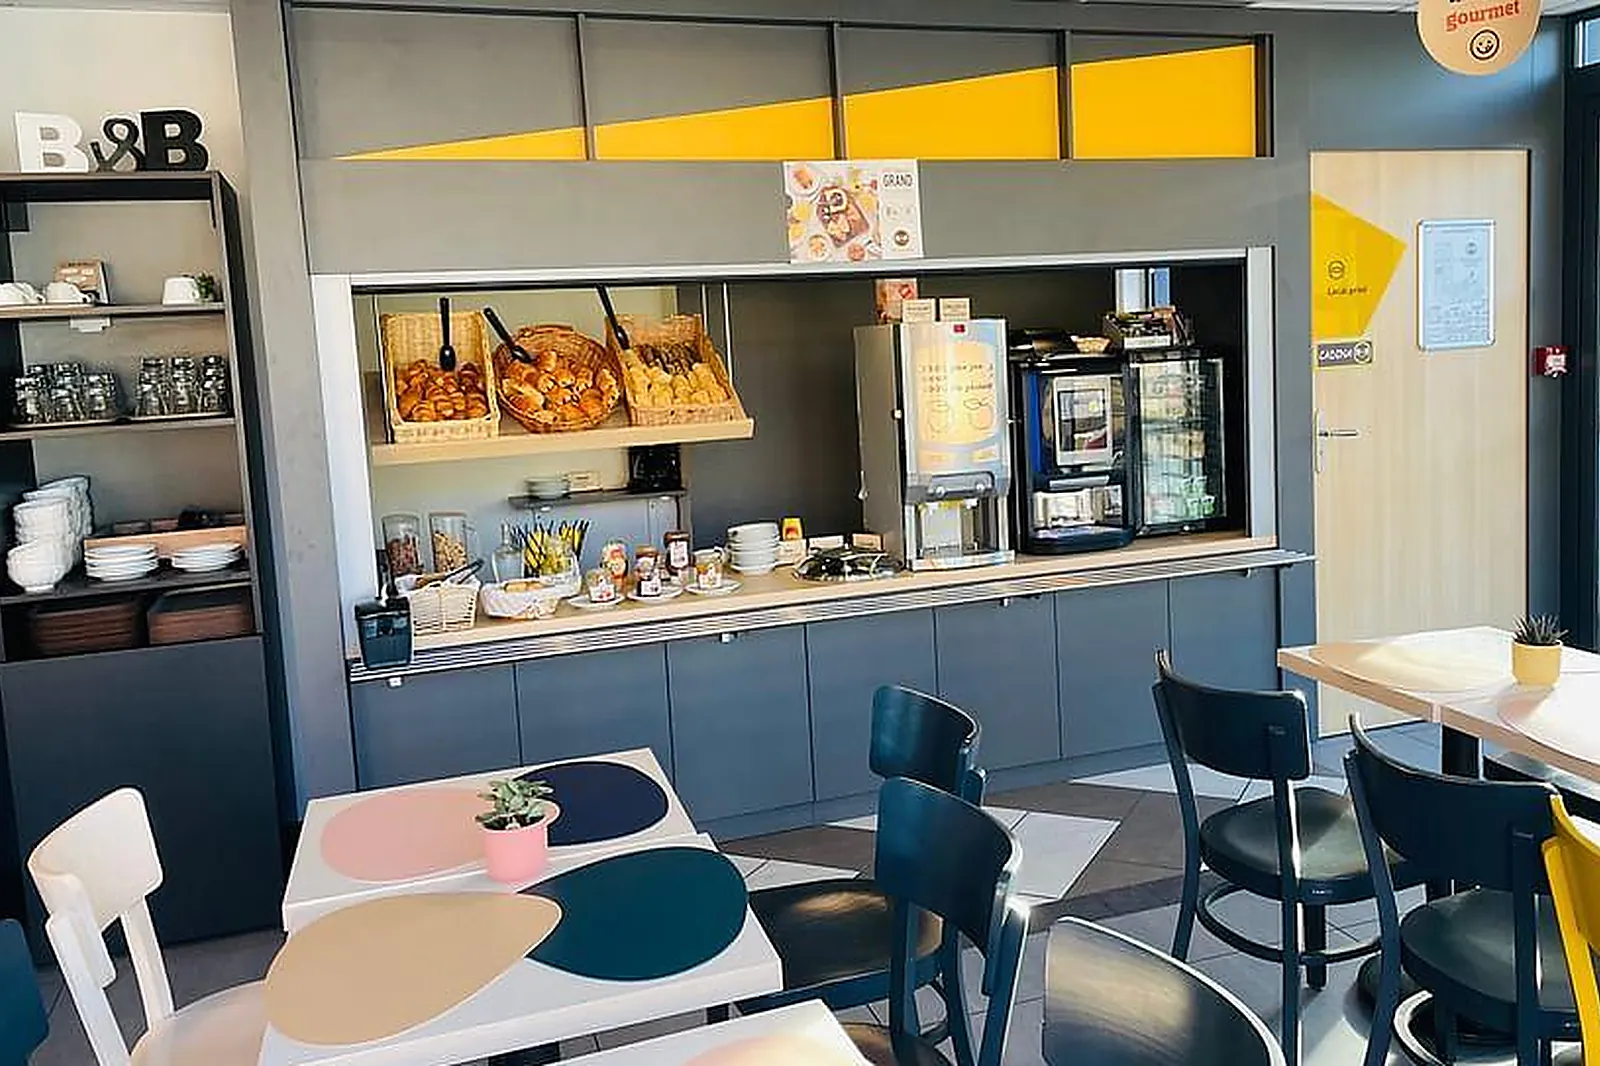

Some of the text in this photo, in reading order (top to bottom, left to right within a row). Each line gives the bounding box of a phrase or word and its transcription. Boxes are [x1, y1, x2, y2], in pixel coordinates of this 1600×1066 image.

[1446, 0, 1520, 32] gourmet
[15, 109, 209, 173] B&B
[882, 174, 913, 188] GRAND
